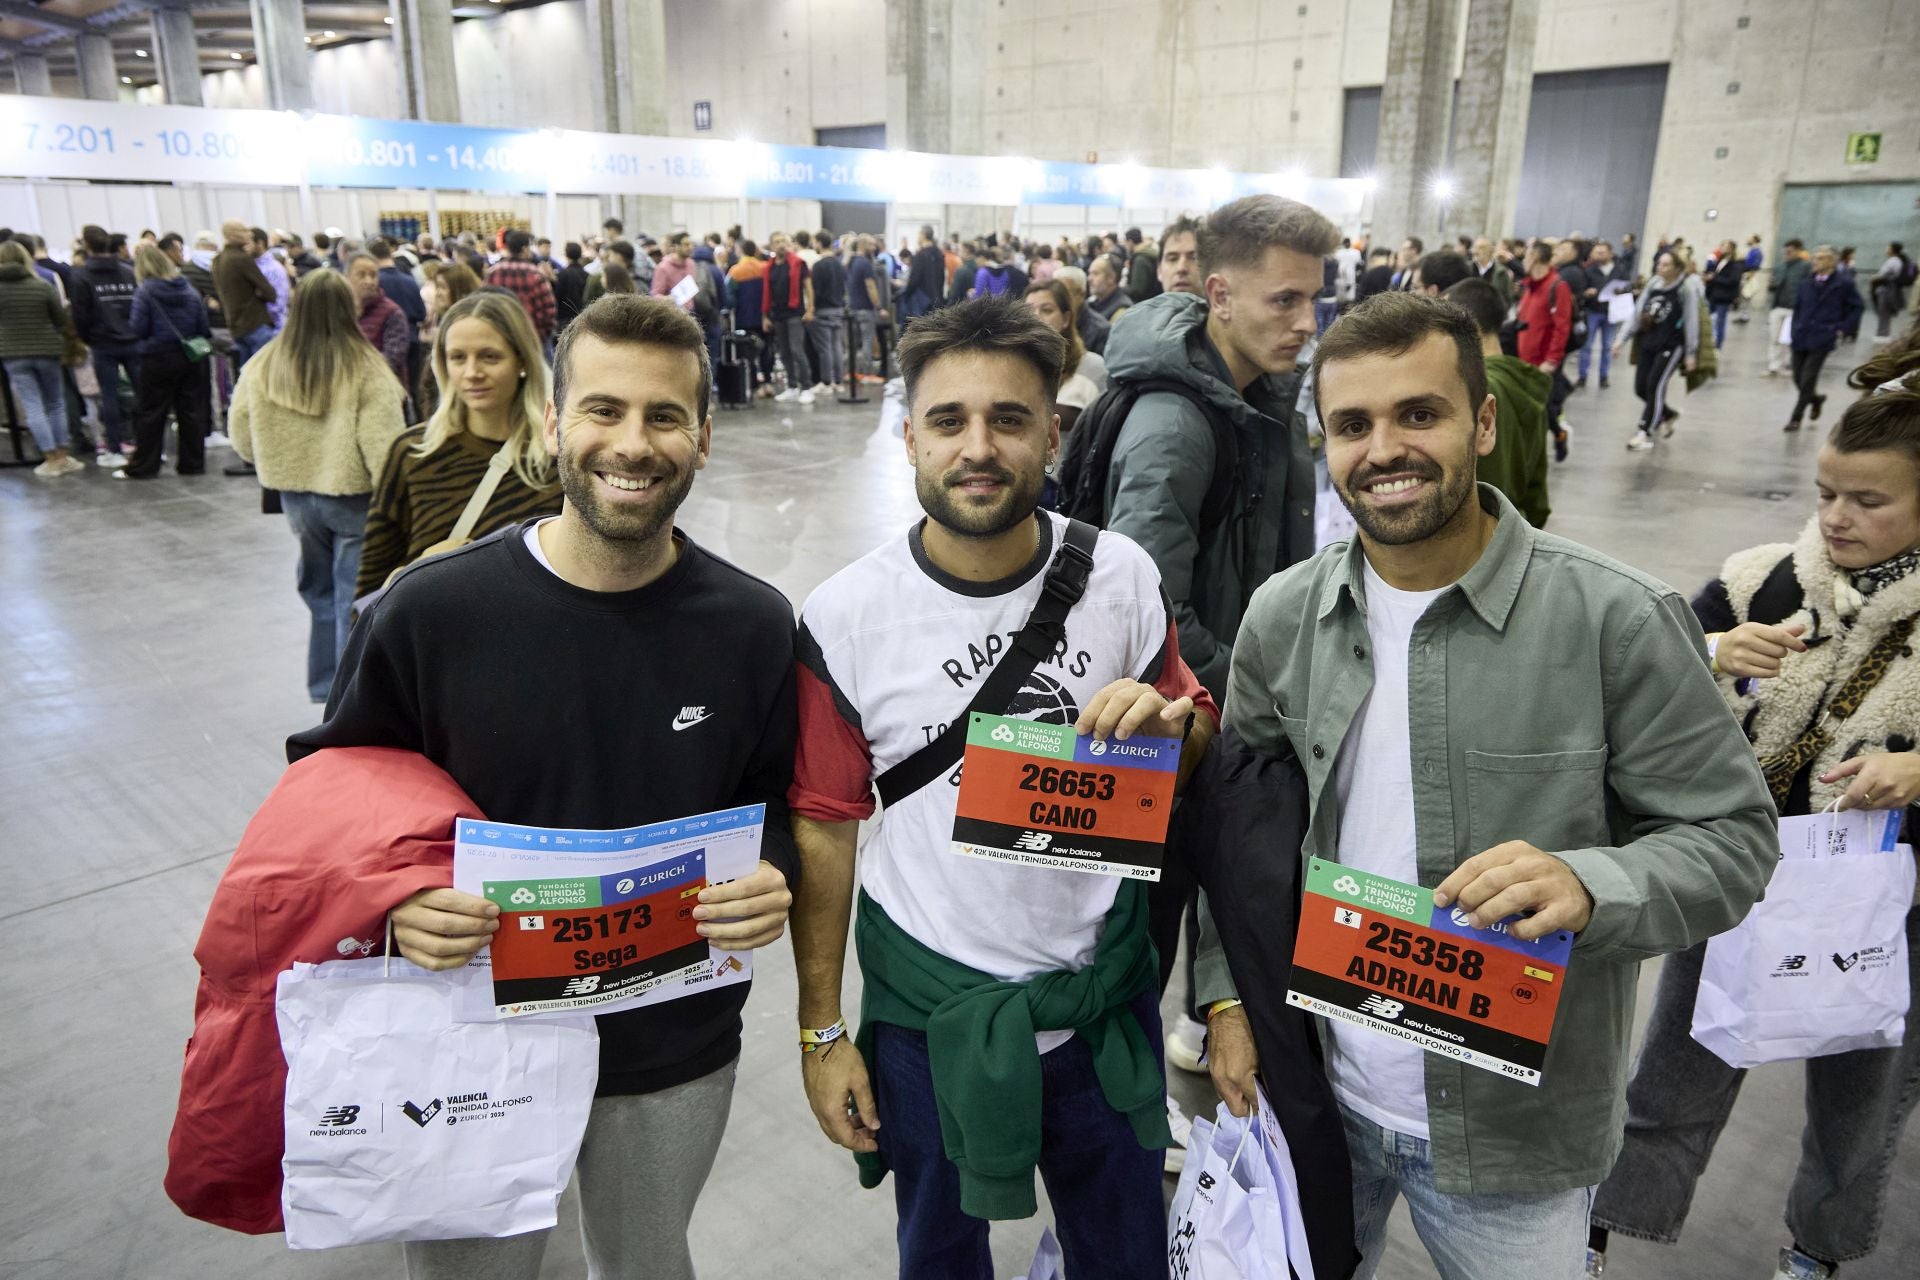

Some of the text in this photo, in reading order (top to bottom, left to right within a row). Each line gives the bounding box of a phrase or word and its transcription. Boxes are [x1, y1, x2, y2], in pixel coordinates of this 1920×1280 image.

[21, 121, 117, 155] 7.201
[679, 706, 706, 721] NIKE
[1018, 725, 1062, 736] FUNDACIÓN
[1018, 731, 1061, 745] TRINIDAD
[1016, 741, 1060, 753] ALFONSO
[1112, 744, 1159, 758] ZURICH
[1019, 764, 1116, 800] 26653
[1141, 798, 1153, 807] 09
[1030, 802, 1097, 830] CANO
[973, 848, 987, 856] 42K
[988, 850, 1019, 860] VALENCIA
[1021, 856, 1059, 865] TRINIDAD
[1060, 862, 1099, 871] ALFONSO
[1132, 869, 1149, 877] 2025
[1069, 849, 1101, 858] balance
[640, 865, 686, 886] ZURICH
[538, 889, 586, 897] TRINIDAD
[1364, 886, 1416, 907] TRINIDAD
[1366, 879, 1418, 897] FUNDACIÓN
[540, 896, 586, 905] ALFONSO
[1362, 895, 1414, 915] ALFONSO
[679, 908, 690, 917] 09
[552, 904, 652, 943] 25173
[574, 943, 637, 970] Sega
[1365, 922, 1485, 981] 25358
[538, 1001, 571, 1010] VALENCIA
[573, 994, 614, 1007] TRINIDAD
[614, 981, 653, 998] ALFONSO
[684, 965, 701, 975] 2025
[603, 971, 654, 990] new balance
[684, 974, 713, 986] VALENCIA
[1346, 956, 1492, 1019] ADRIAN B
[1516, 988, 1532, 1000] 09
[1312, 1001, 1328, 1012] 42K
[1328, 1006, 1364, 1025] VALENCIA
[1366, 1019, 1412, 1040] TRINIDAD
[1412, 1035, 1461, 1056] ALFONSO
[1502, 1063, 1525, 1077] 2025
[1404, 1018, 1465, 1043] new balance
[447, 1092, 488, 1105] VALENCIA
[447, 1096, 533, 1114] TRINIDAD ALFONSO
[420, 1103, 438, 1124] 42K
[460, 1114, 488, 1122] ZURICH
[490, 1111, 505, 1119] 2025
[329, 1128, 367, 1136] balance
